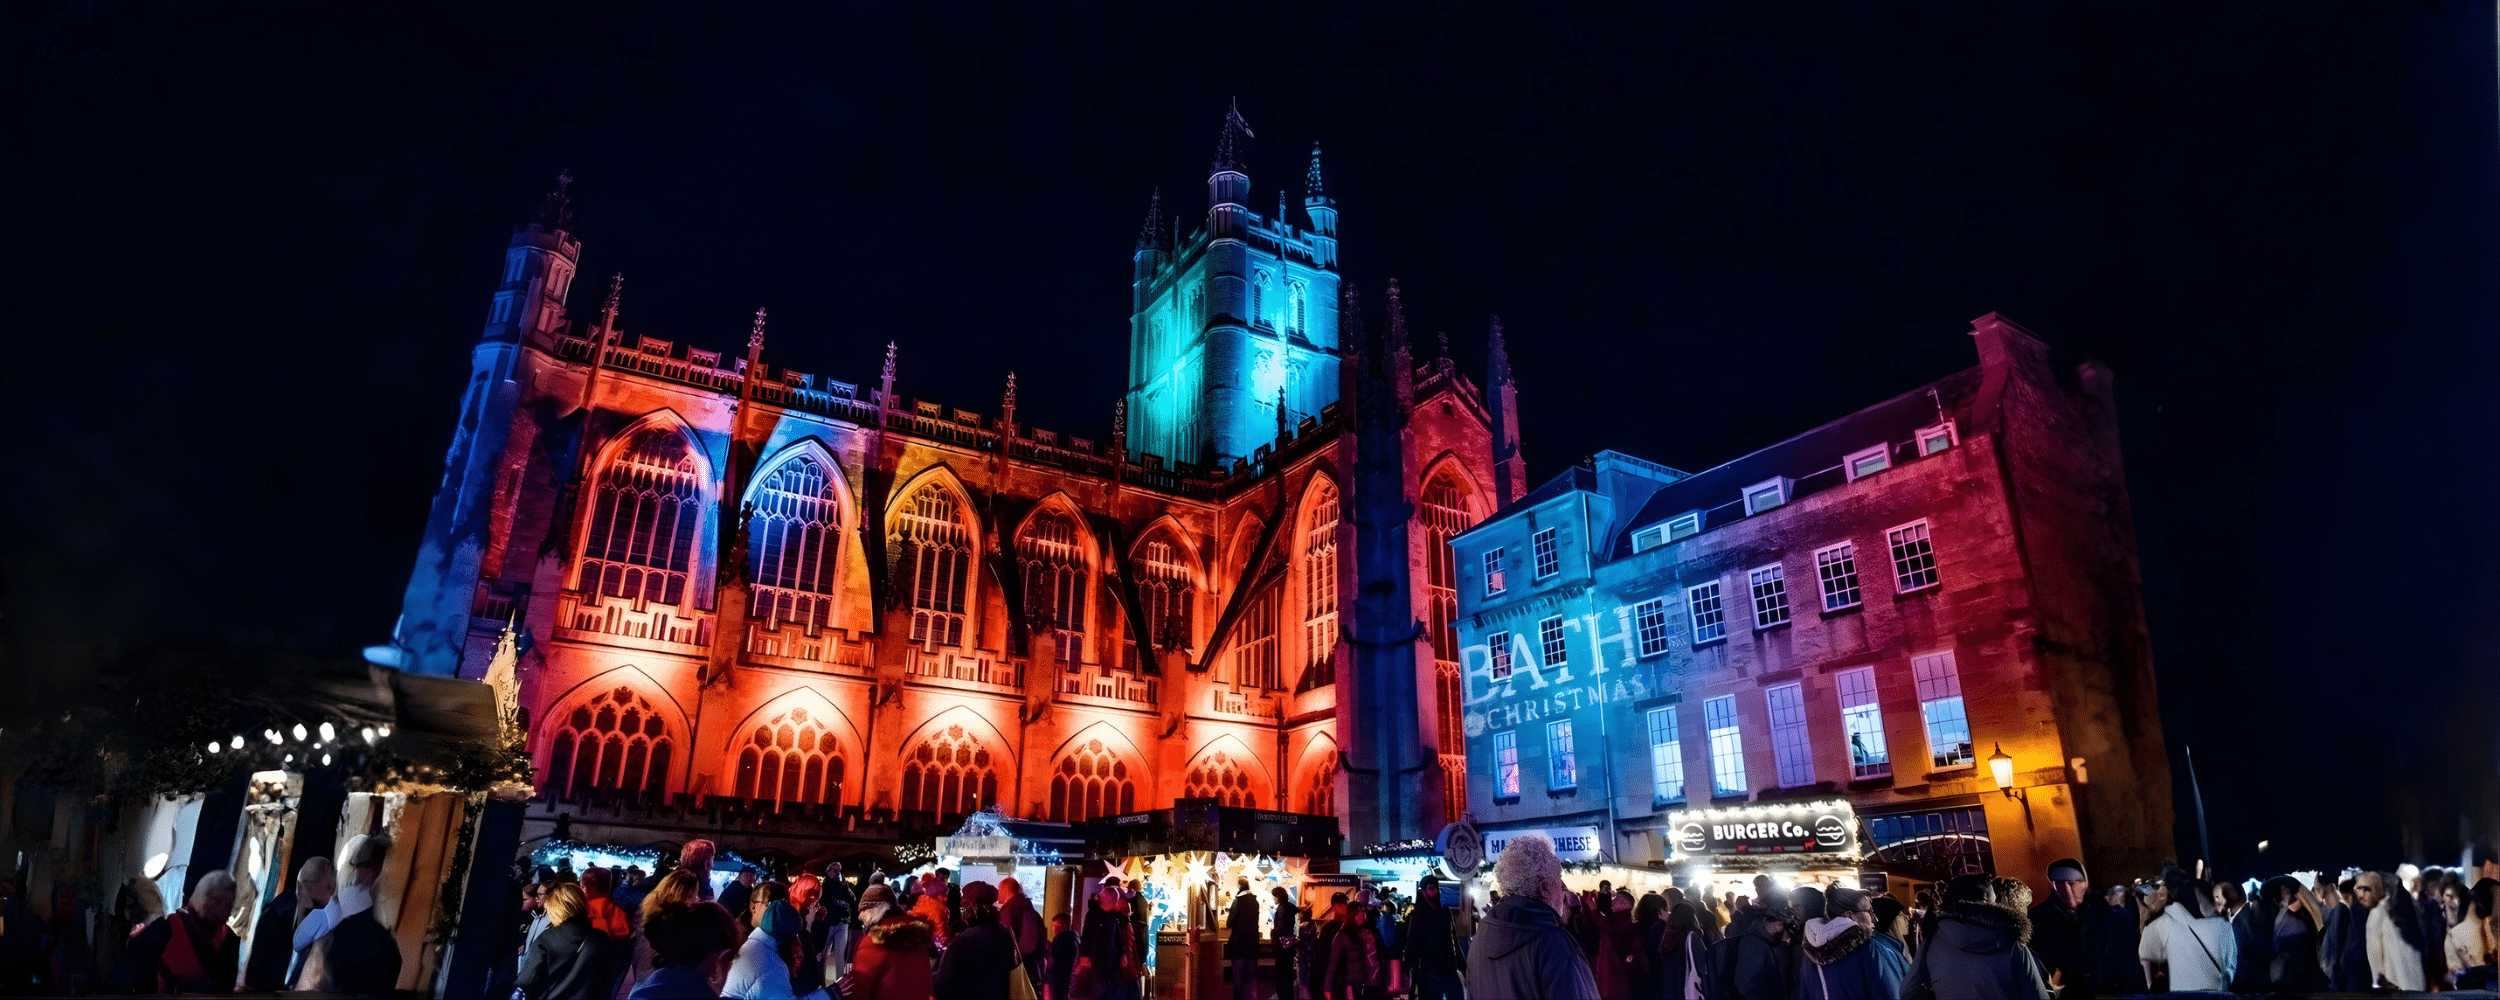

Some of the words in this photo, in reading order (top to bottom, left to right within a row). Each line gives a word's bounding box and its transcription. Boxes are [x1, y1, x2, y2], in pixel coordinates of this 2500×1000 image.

[1487, 673, 1647, 730] CHRISTMAS
[1712, 822, 1780, 841] BURGER
[1782, 821, 1810, 838] Co.
